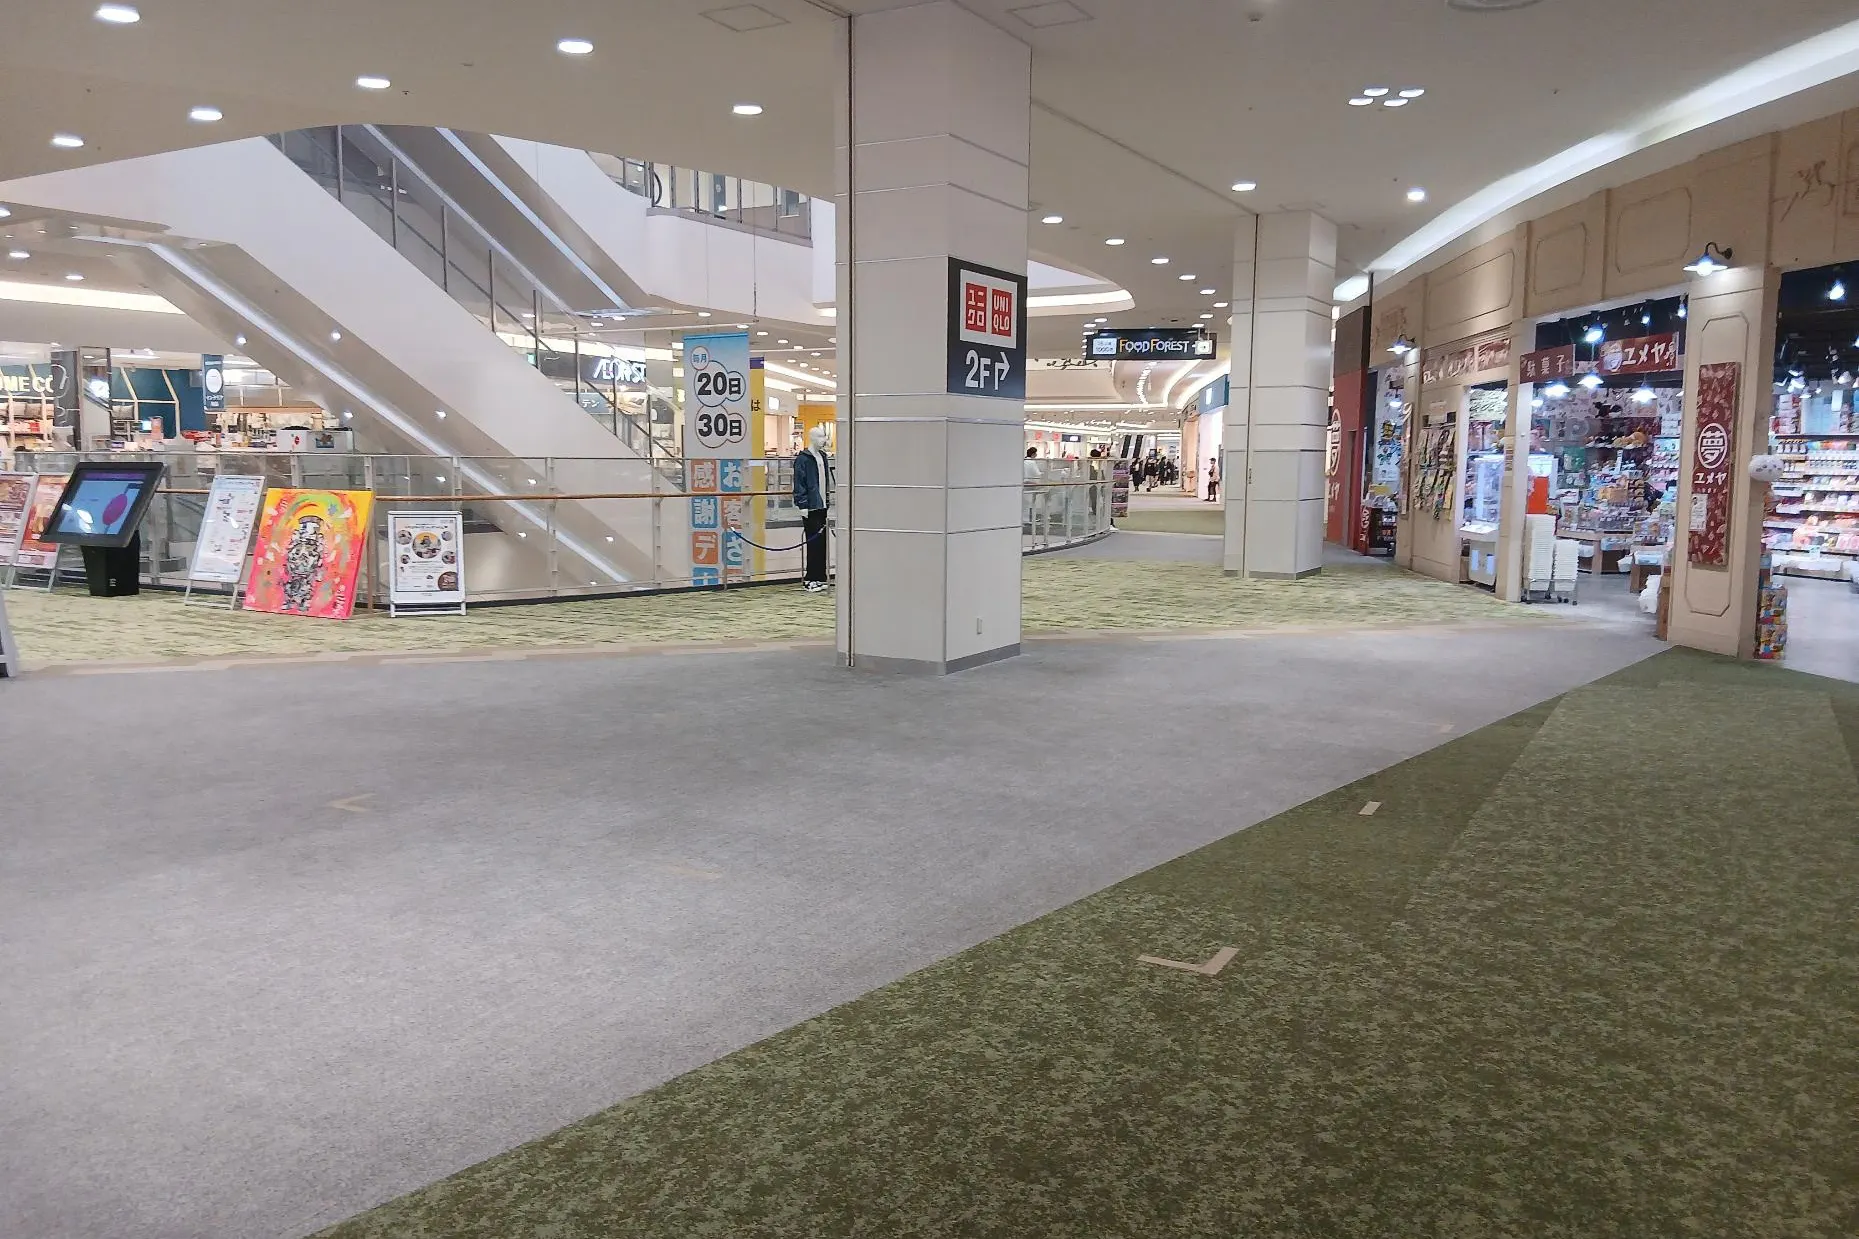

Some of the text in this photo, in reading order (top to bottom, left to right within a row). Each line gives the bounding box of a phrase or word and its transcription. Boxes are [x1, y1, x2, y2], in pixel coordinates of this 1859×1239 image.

[968, 288, 985, 307] ユニ
[993, 294, 1009, 313] UNI
[967, 309, 985, 326] クロ
[993, 314, 1010, 332] QLO
[1622, 343, 1666, 366] ユメヤ
[965, 349, 991, 389] 2F
[697, 371, 741, 396] 20日
[698, 413, 742, 437] 30日
[1694, 472, 1728, 485] ユメヤ
